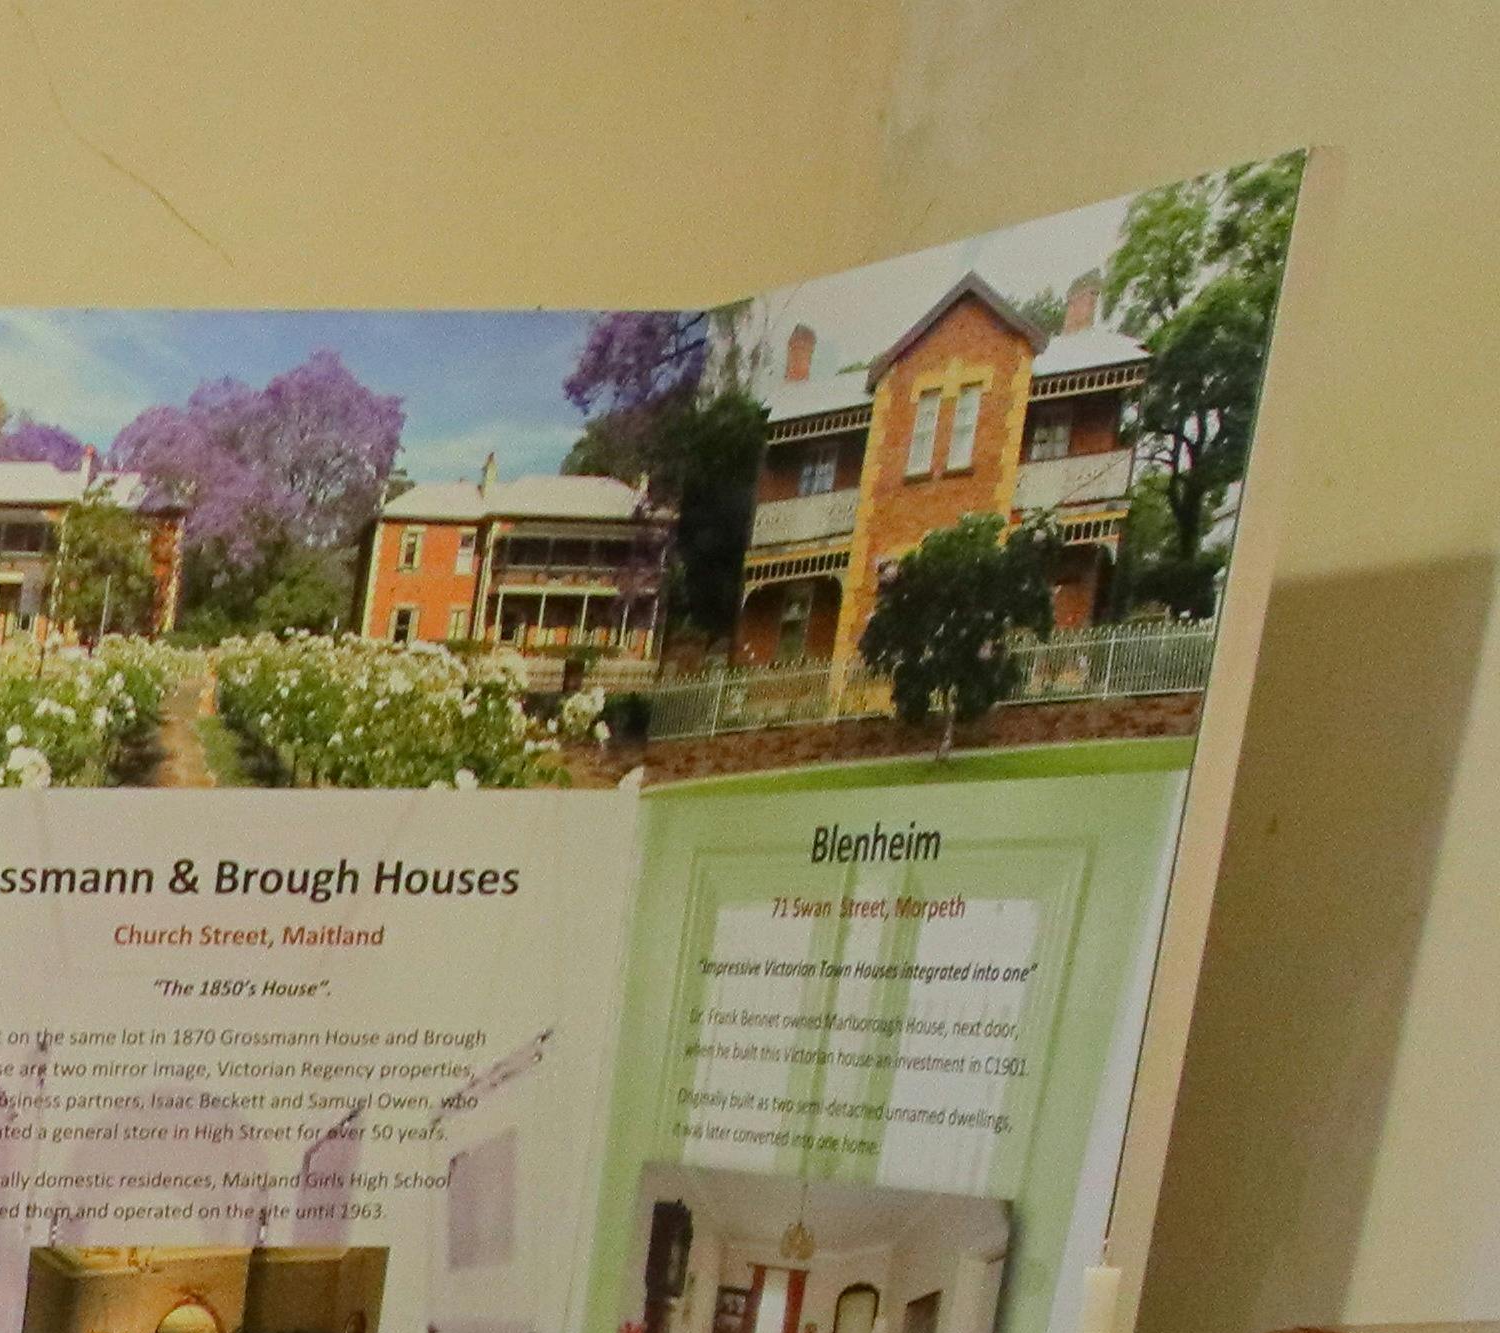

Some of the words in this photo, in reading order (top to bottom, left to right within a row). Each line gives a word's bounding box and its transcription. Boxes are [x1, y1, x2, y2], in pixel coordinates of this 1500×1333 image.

[811, 821, 942, 863] Blenheim
[168, 858, 198, 894] &
[215, 859, 359, 903] Brough
[374, 861, 519, 895] Houses
[772, 897, 787, 917] 71
[793, 897, 831, 917] Swan
[839, 897, 889, 921] Street,
[895, 893, 966, 922] Morpeth
[114, 924, 192, 944] Church
[200, 925, 273, 948] Street,
[282, 925, 384, 945] Maitland
